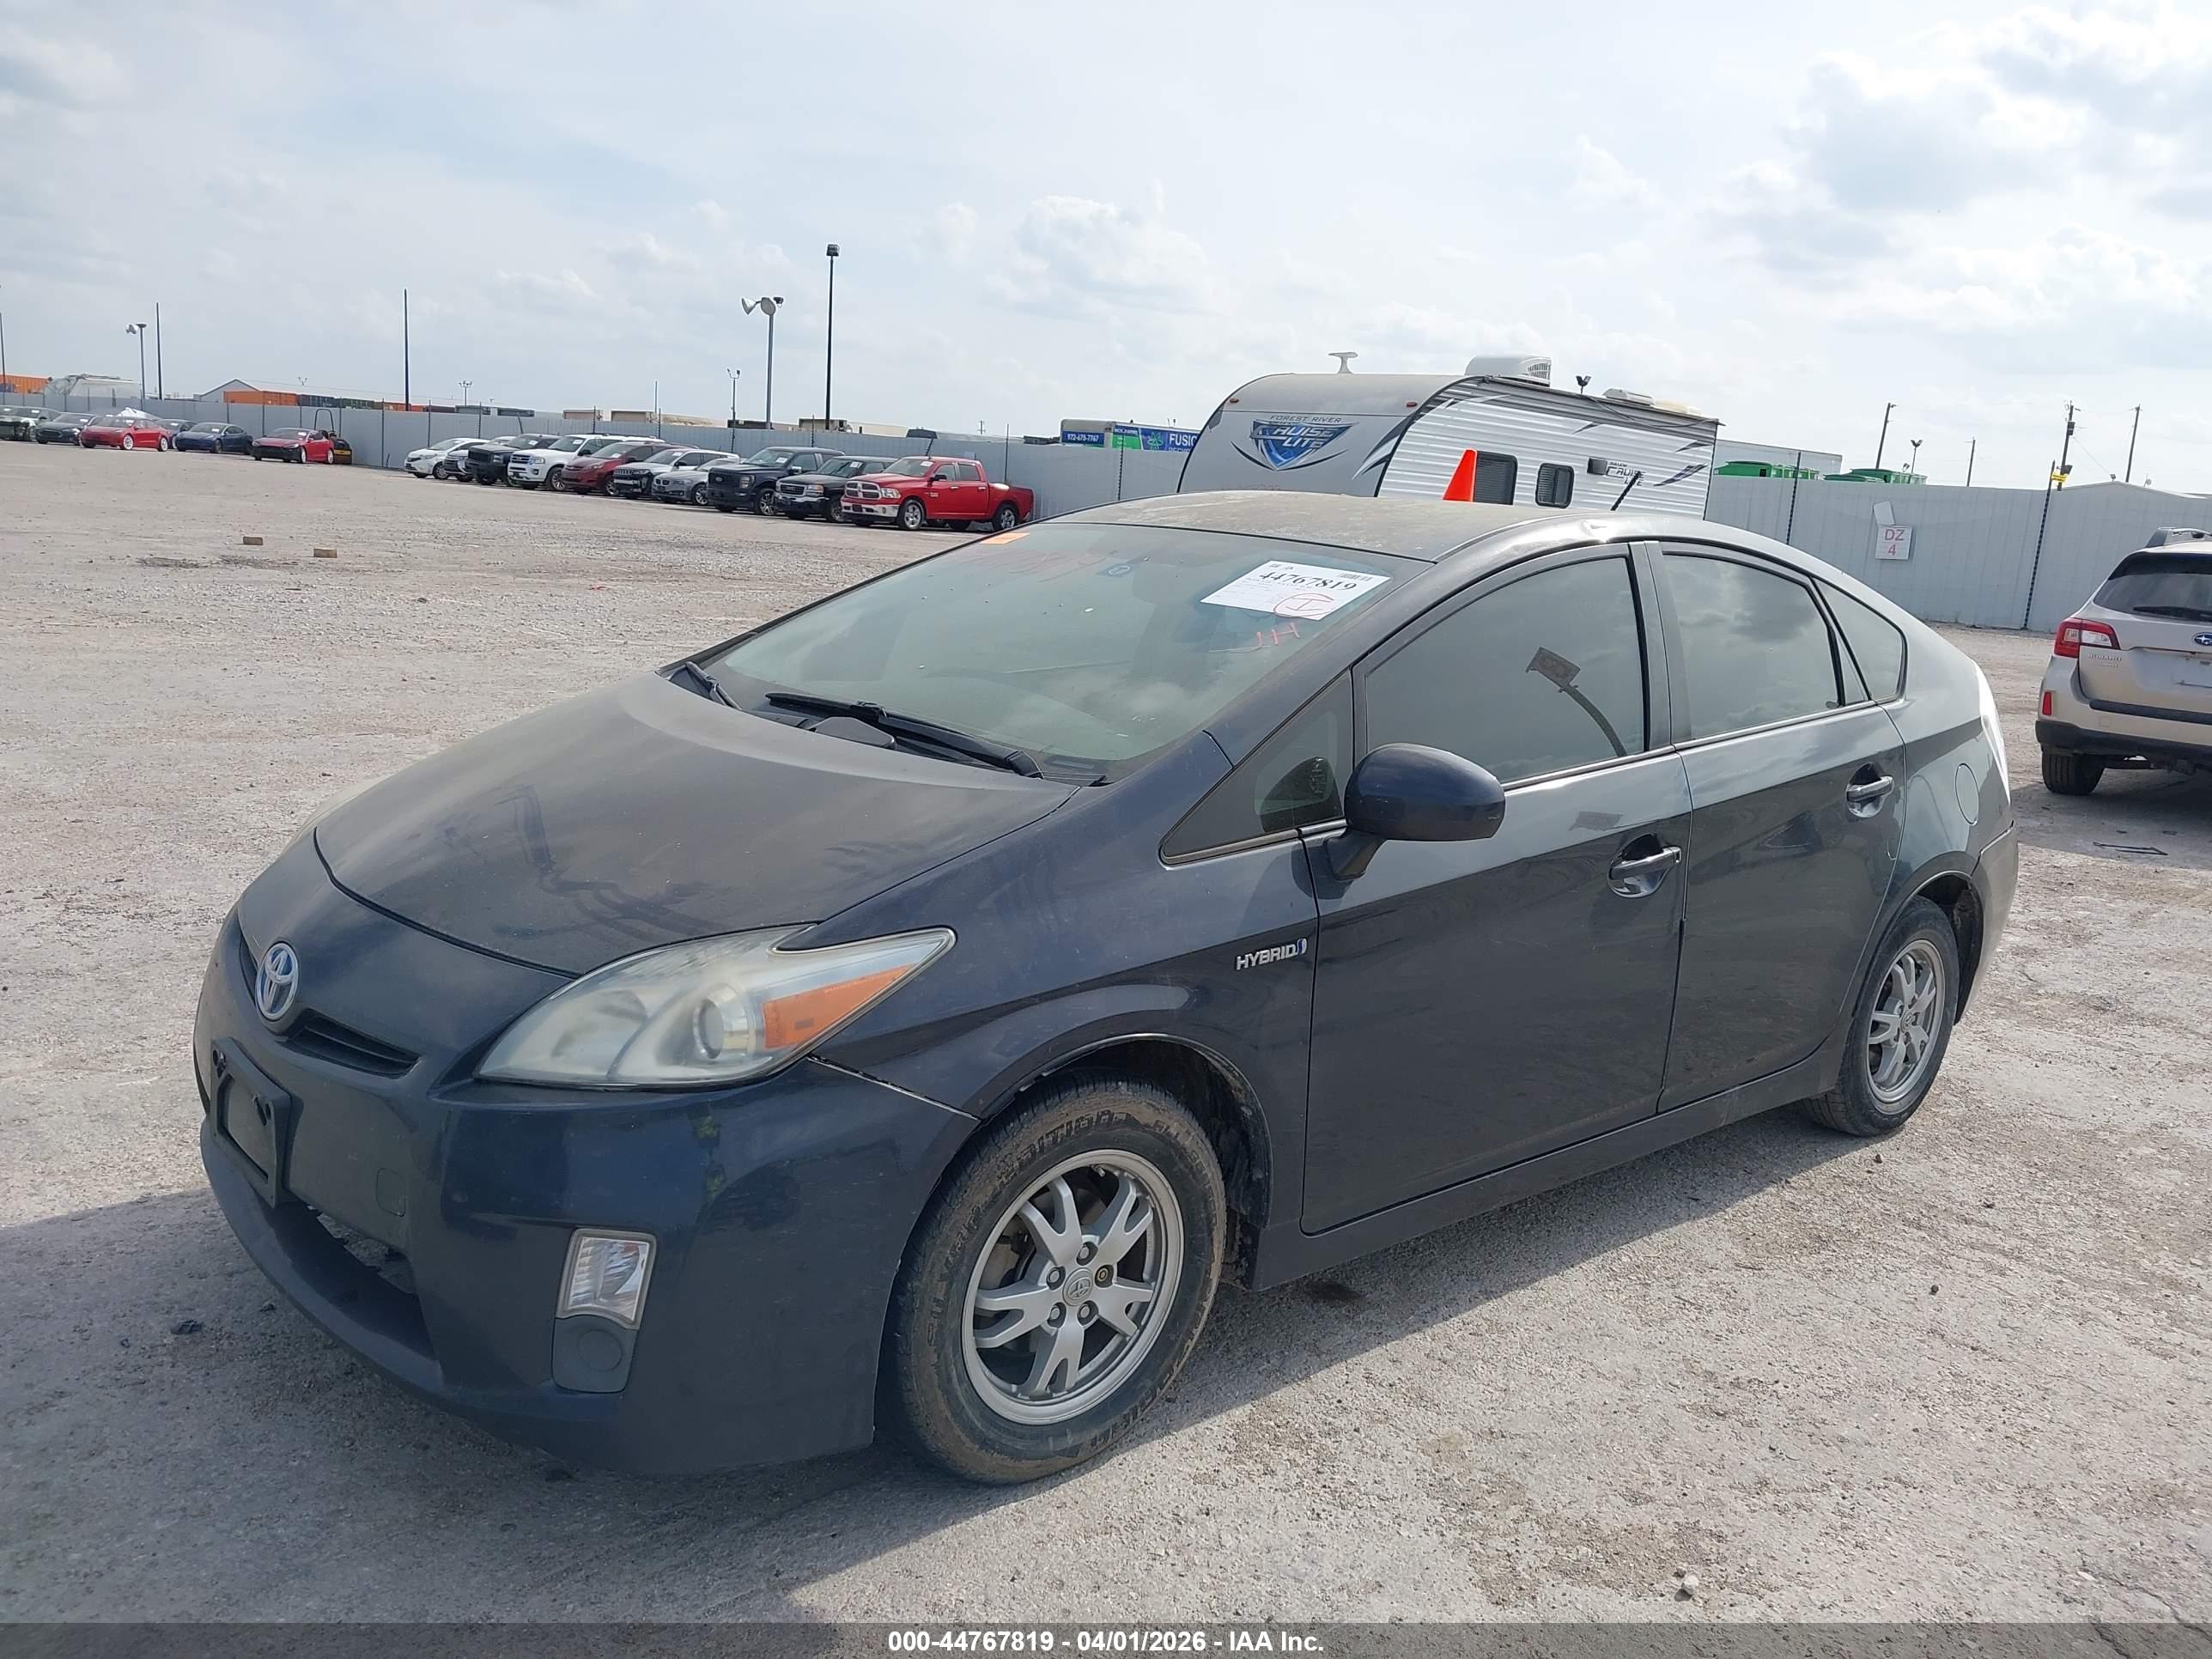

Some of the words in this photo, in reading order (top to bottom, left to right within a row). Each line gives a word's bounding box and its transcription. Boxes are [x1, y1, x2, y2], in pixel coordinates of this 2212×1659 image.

[1282, 437, 1328, 448] LITE
[1885, 529, 1905, 541] DZ
[1888, 544, 1897, 556] 4
[1259, 571, 1358, 591] 44767819
[1237, 944, 1298, 970] HYBRID
